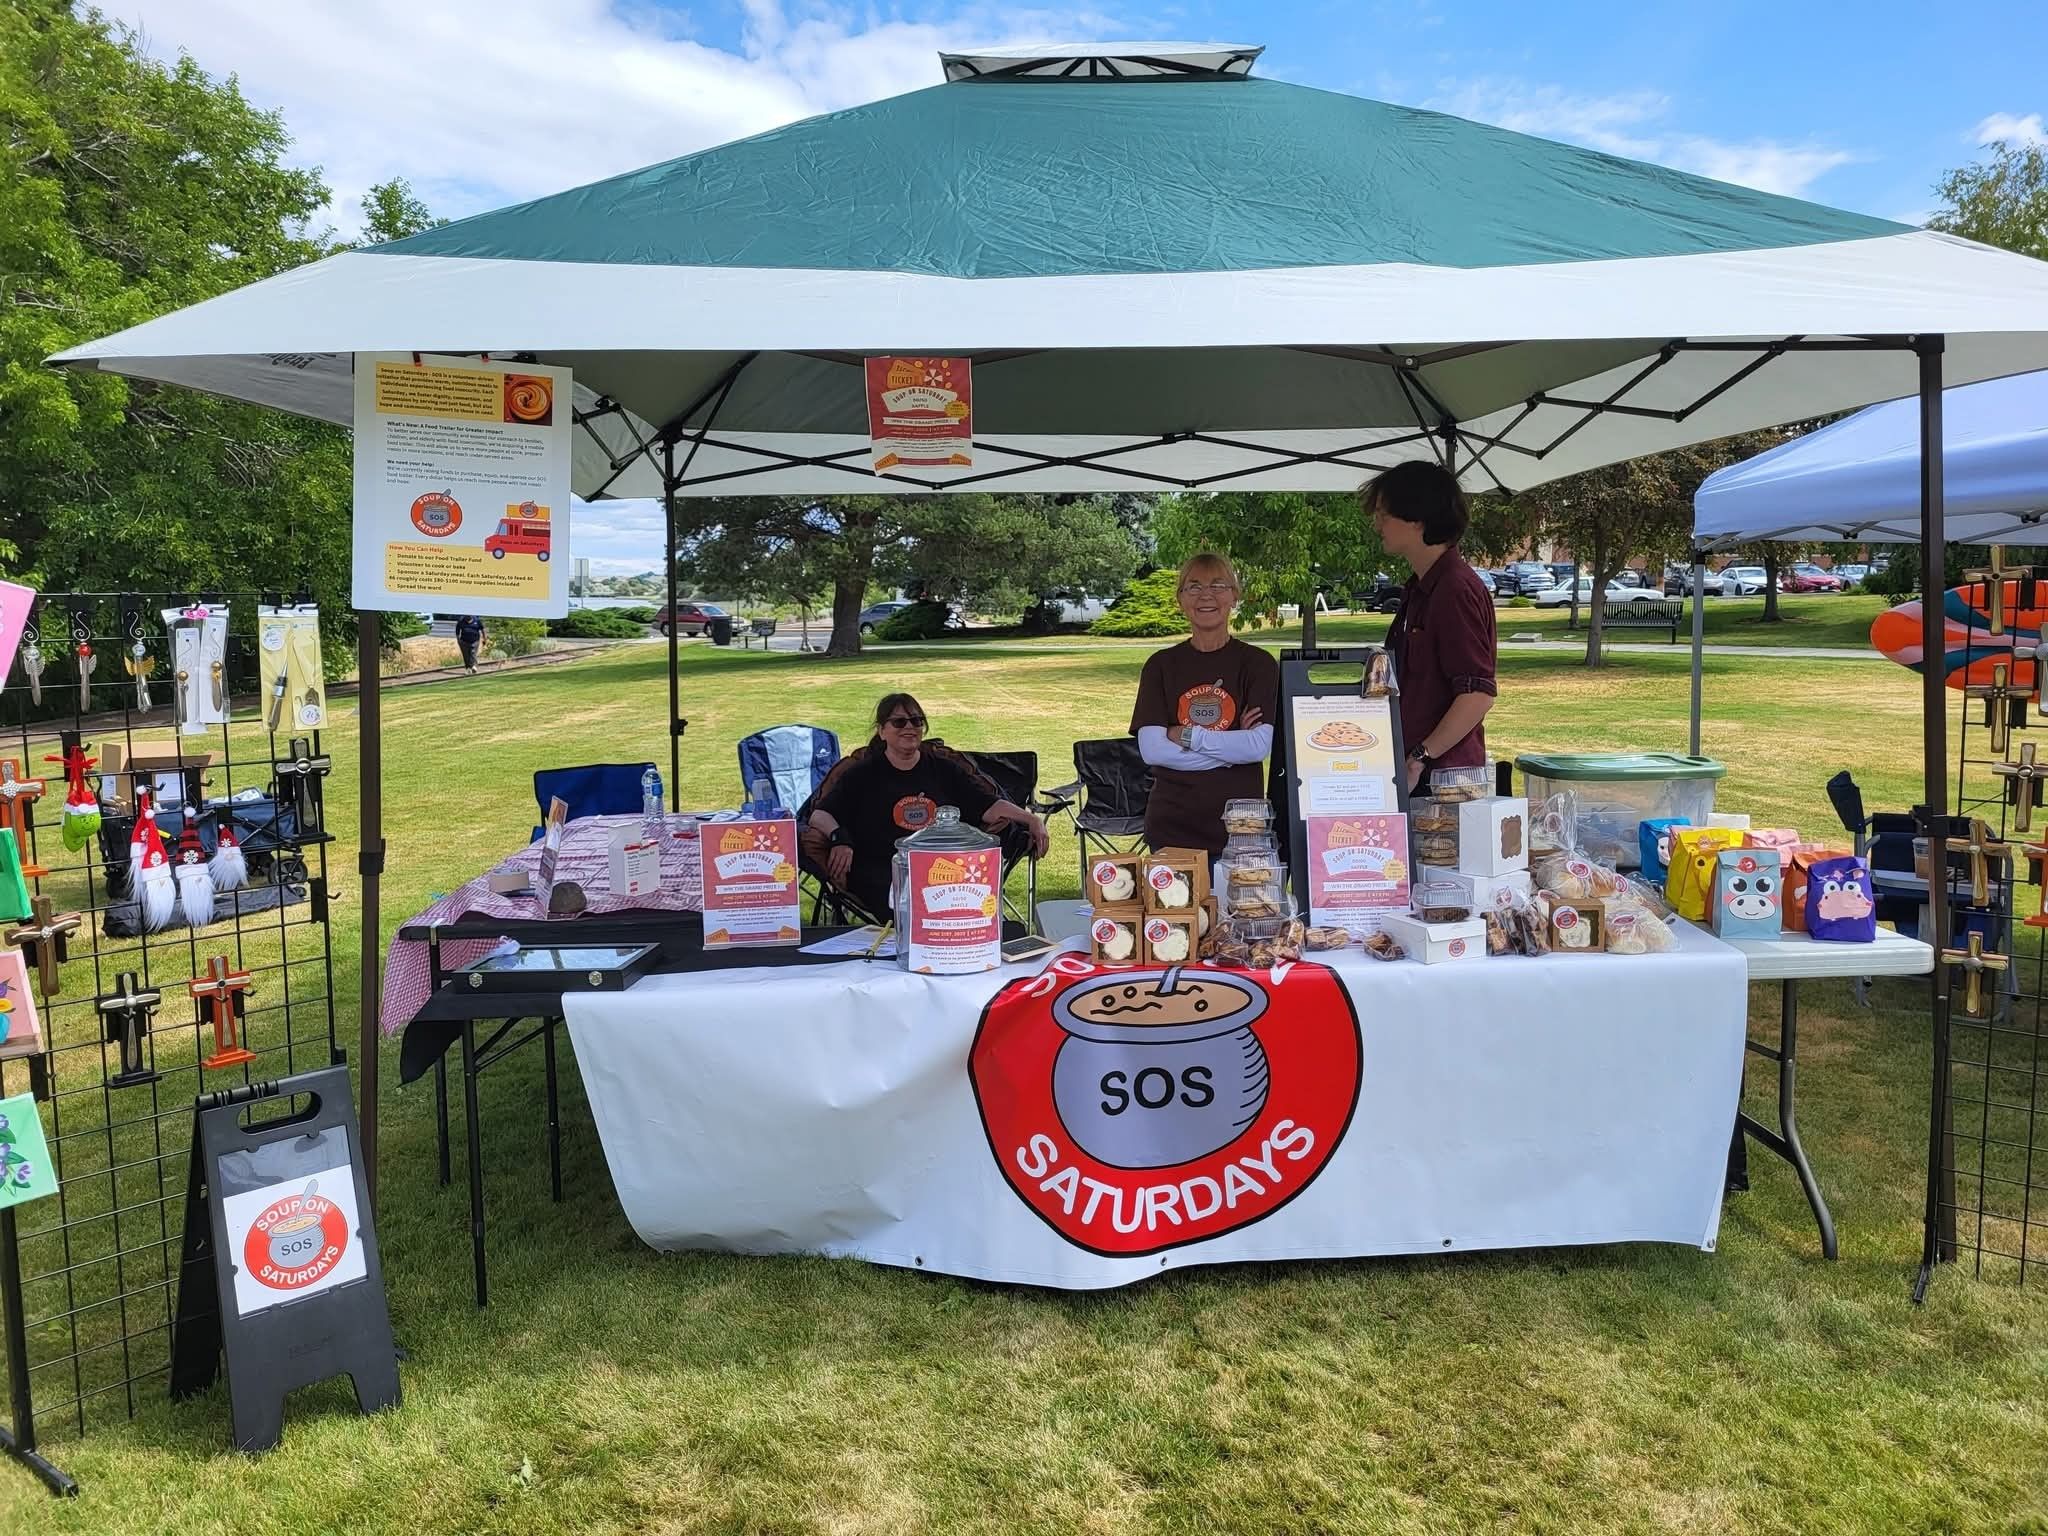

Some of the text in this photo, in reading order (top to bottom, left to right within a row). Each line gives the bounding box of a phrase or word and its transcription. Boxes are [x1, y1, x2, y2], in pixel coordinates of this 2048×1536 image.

[892, 376, 913, 384] TICKET
[892, 392, 906, 404] SOUP
[918, 388, 947, 403] SATURDAY
[418, 495, 441, 504] SOUP
[417, 520, 456, 534] SATURDAYS
[1184, 687, 1228, 699] SOUP ON
[724, 856, 737, 868] SOUP
[748, 852, 775, 866] SATURDAY
[1332, 852, 1346, 864] SOUP
[1358, 848, 1384, 862] SATURDAY
[932, 872, 953, 881] TICKET
[932, 889, 946, 901] SOUP
[959, 886, 984, 899] SATURDAY
[1099, 1066, 1215, 1117] SOS
[1016, 1118, 1315, 1234] SATURDAYS
[256, 1199, 329, 1232] SOUP ON
[281, 1238, 313, 1256] SOS
[260, 1245, 339, 1285] SATURDAYS
